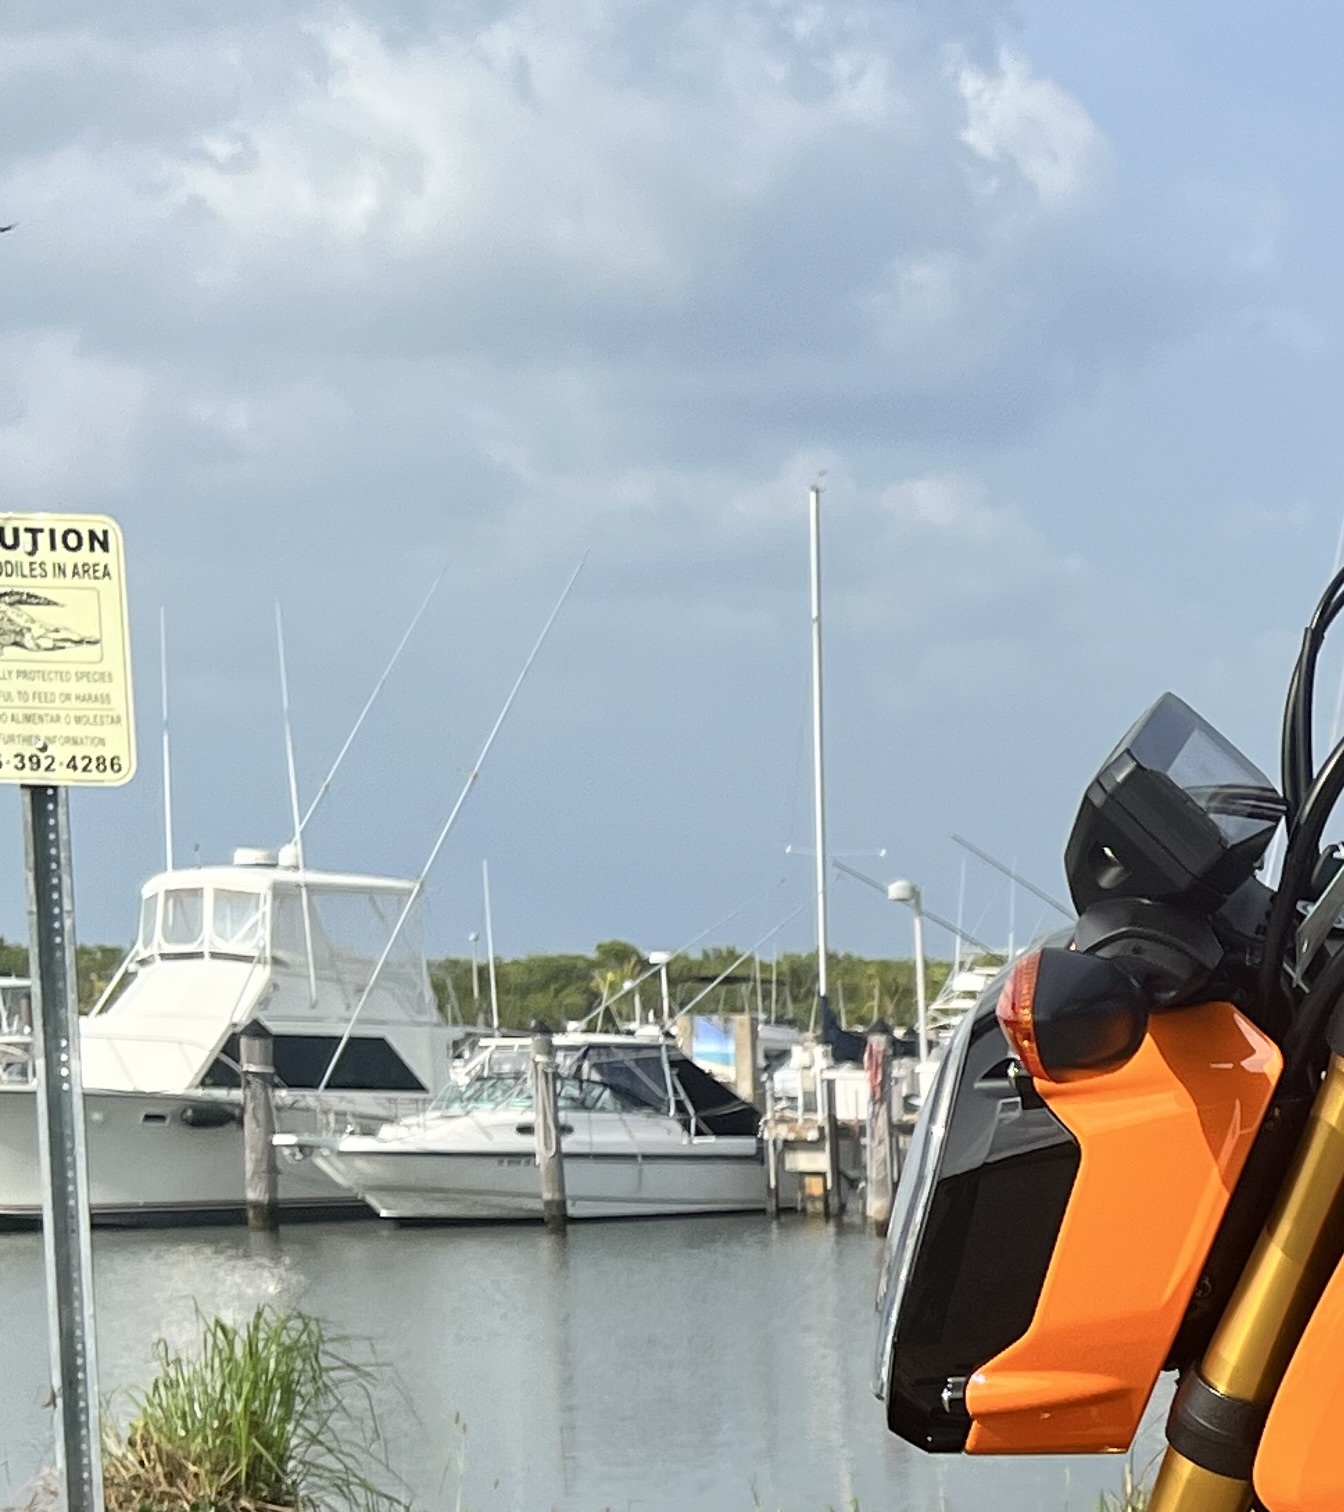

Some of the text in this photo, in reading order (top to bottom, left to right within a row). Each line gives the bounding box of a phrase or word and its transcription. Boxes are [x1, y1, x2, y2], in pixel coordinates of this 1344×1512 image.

[52, 562, 67, 580] IN
[71, 562, 112, 581] AREA
[16, 669, 72, 683] PROTECTED
[74, 670, 114, 684] SPECIES
[17, 690, 29, 704] TO
[32, 690, 57, 704] FEED
